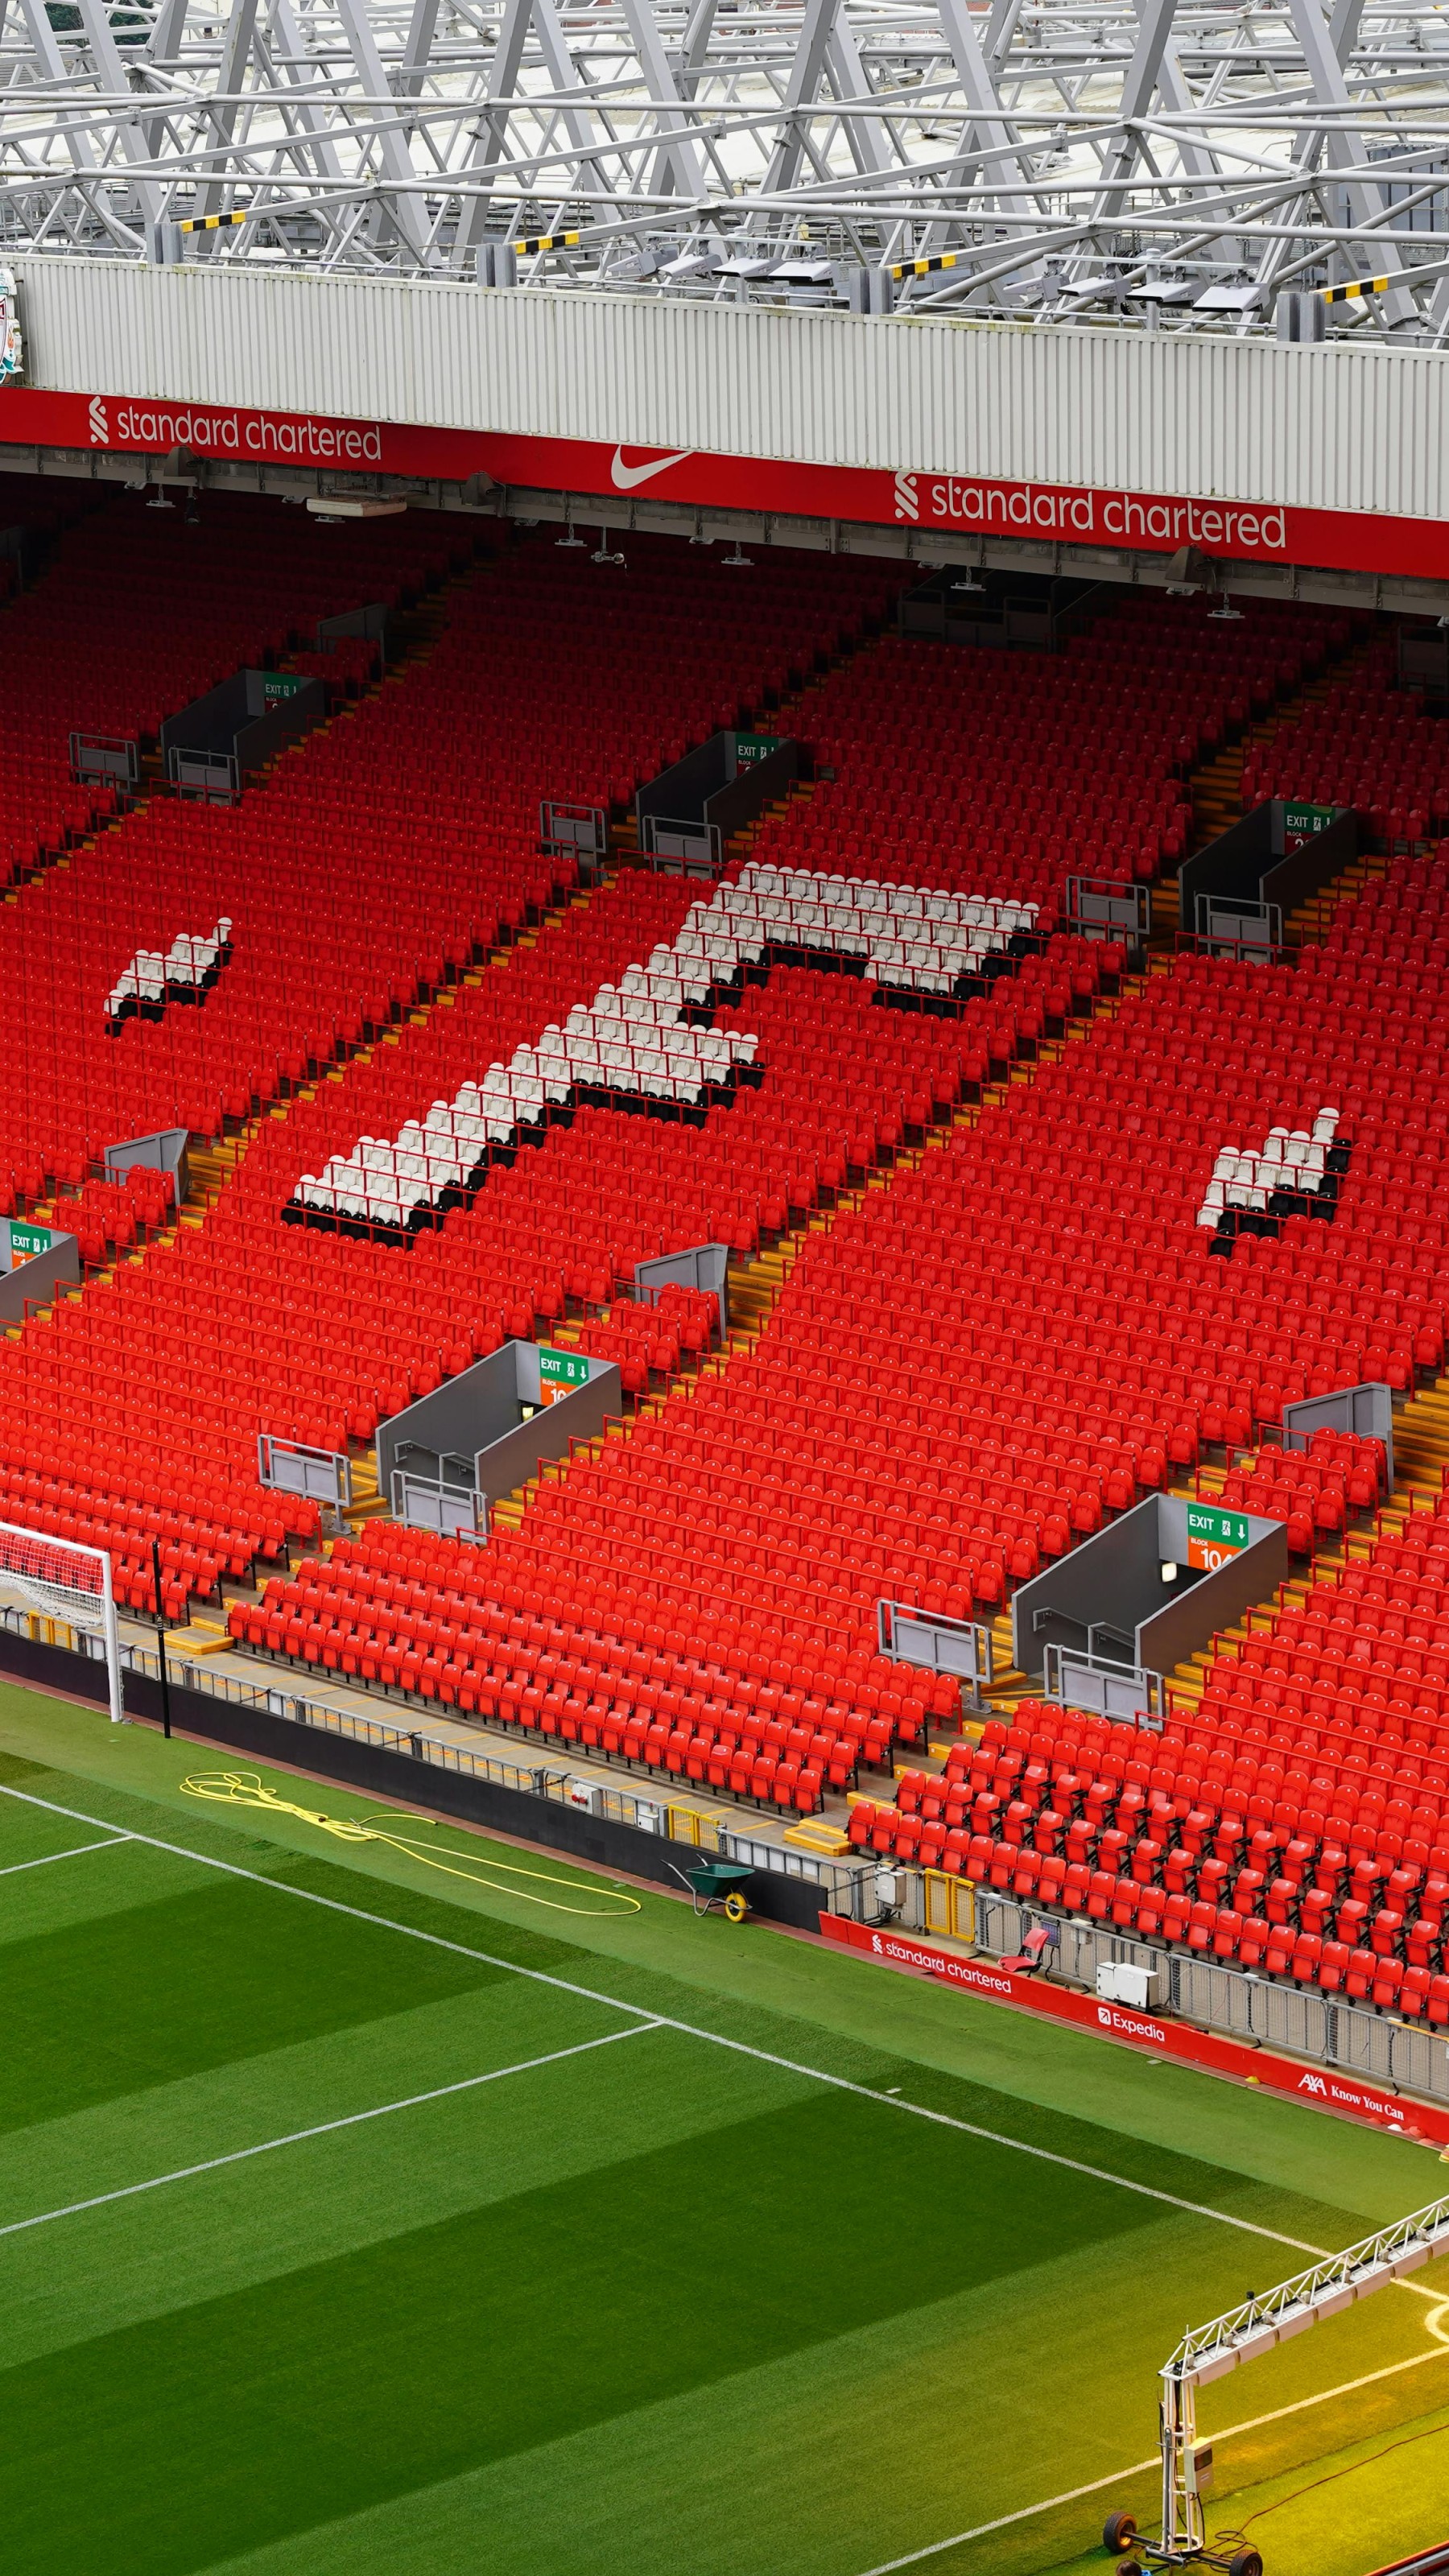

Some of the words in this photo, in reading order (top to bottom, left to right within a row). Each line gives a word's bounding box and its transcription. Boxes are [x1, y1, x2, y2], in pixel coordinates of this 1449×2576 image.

[118, 405, 239, 448] standard
[246, 415, 382, 460] chartered
[931, 478, 1094, 530] standard
[1103, 493, 1286, 548] chartered
[265, 683, 282, 695] EXIT
[737, 745, 757, 757] EXIT
[1286, 815, 1308, 828] EXIT
[12, 1234, 31, 1249] EXIT
[540, 1357, 561, 1373] EXIT
[542, 1378, 557, 1386] BLOCK
[1189, 1513, 1215, 1530] EXIT
[1191, 1537, 1208, 1546] BLOCK
[886, 1942, 945, 1972] standard
[947, 1962, 1012, 1994] chartered
[1113, 2013, 1166, 2042] Expedia
[1298, 2073, 1327, 2096] AXA
[1331, 2084, 1361, 2105] Know
[1362, 2095, 1383, 2113] You
[1384, 2103, 1405, 2121] Can
